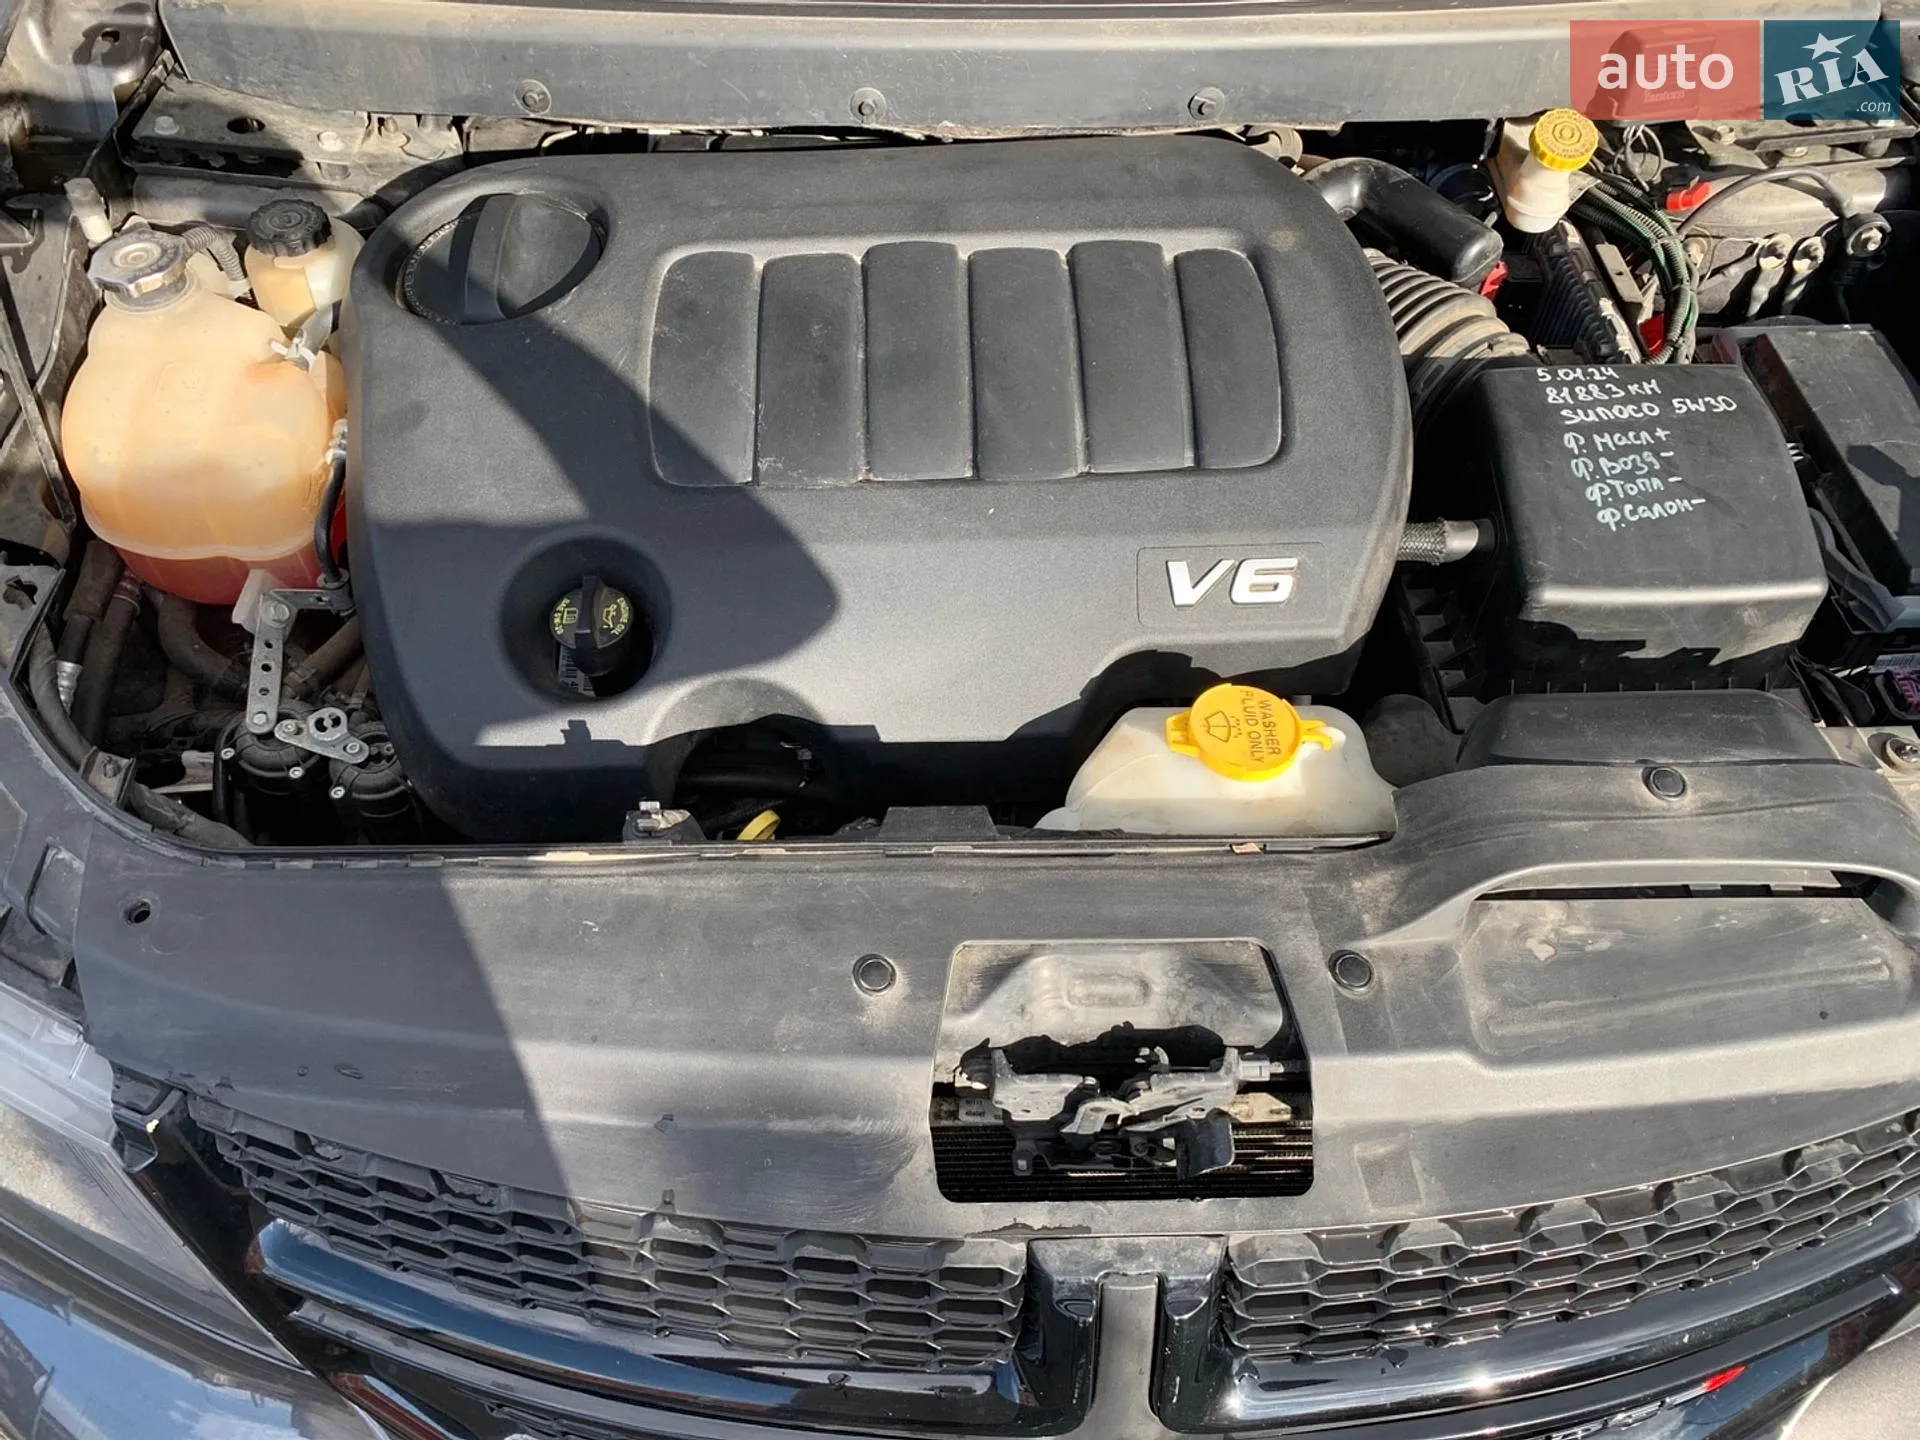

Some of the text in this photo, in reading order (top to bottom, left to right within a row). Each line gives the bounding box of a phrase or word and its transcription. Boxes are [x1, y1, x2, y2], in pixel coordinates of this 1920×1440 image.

[1545, 383, 1626, 404] 81883
[1672, 395, 1737, 414] 5W30
[1166, 557, 1299, 607] V6
[610, 624, 625, 635] OIL
[1239, 690, 1265, 764] FLUID ONLY
[1259, 699, 1281, 756] WASHER
